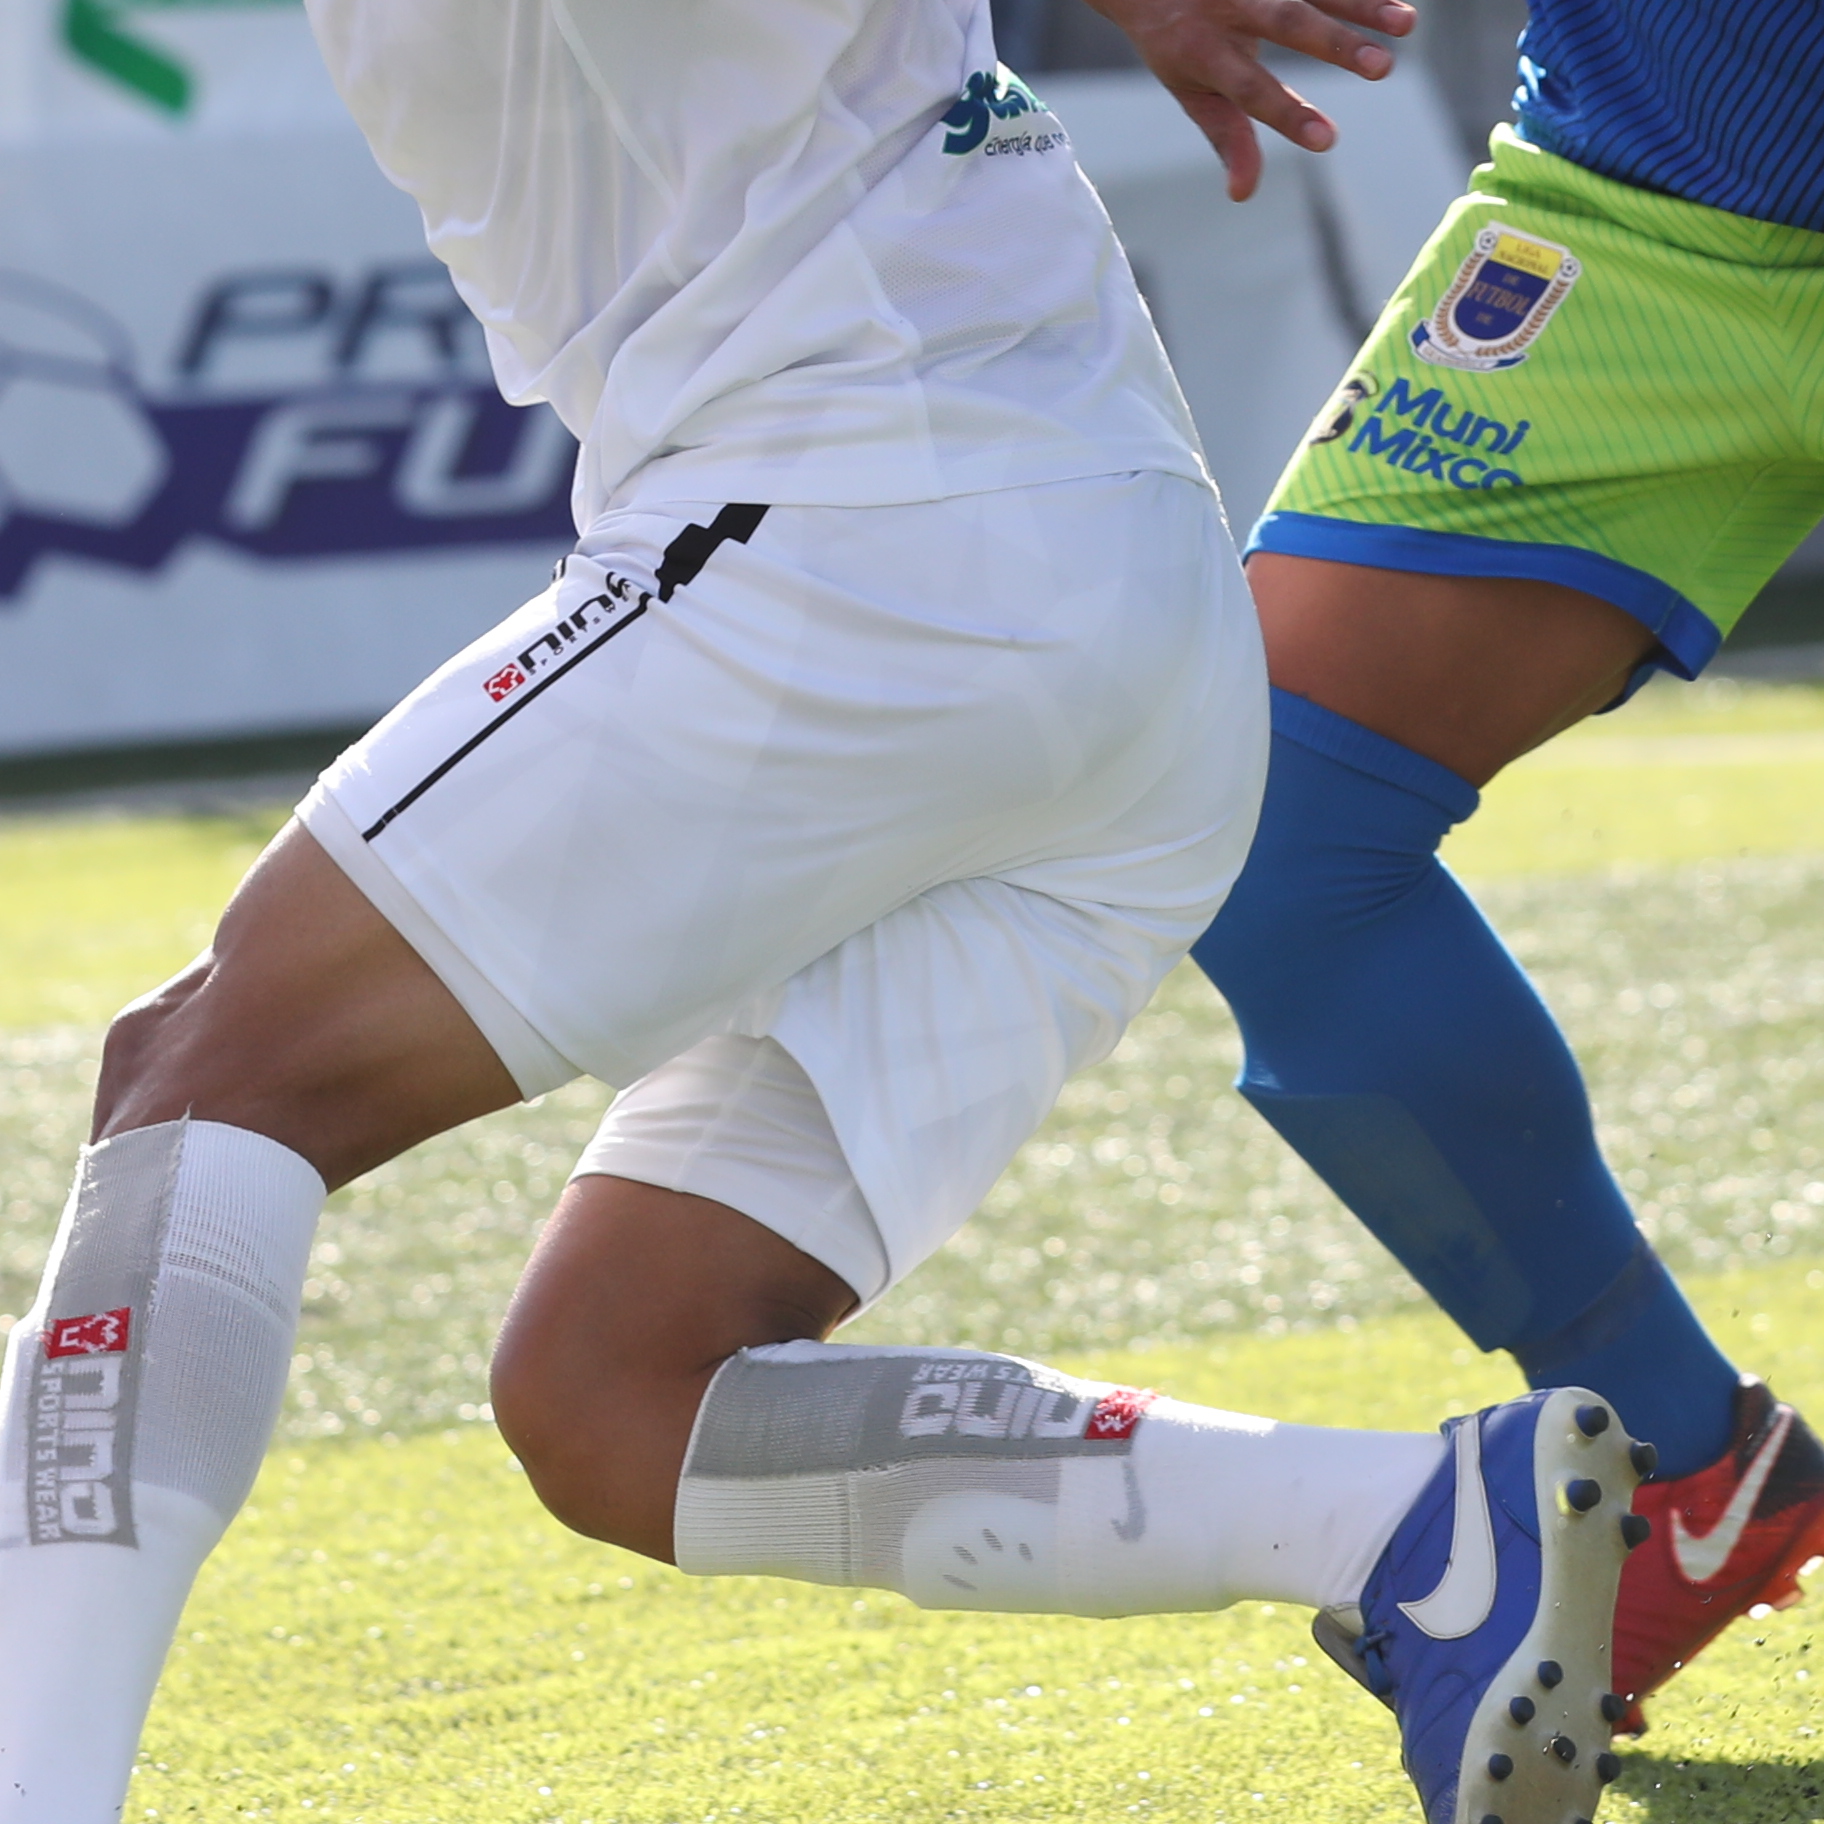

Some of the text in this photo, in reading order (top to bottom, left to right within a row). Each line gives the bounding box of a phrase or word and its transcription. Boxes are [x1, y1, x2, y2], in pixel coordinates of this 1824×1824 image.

[1347, 415, 1525, 491] Mixco
[1373, 376, 1531, 456] Muni
[33, 1360, 65, 1541] SPORTS WEAR
